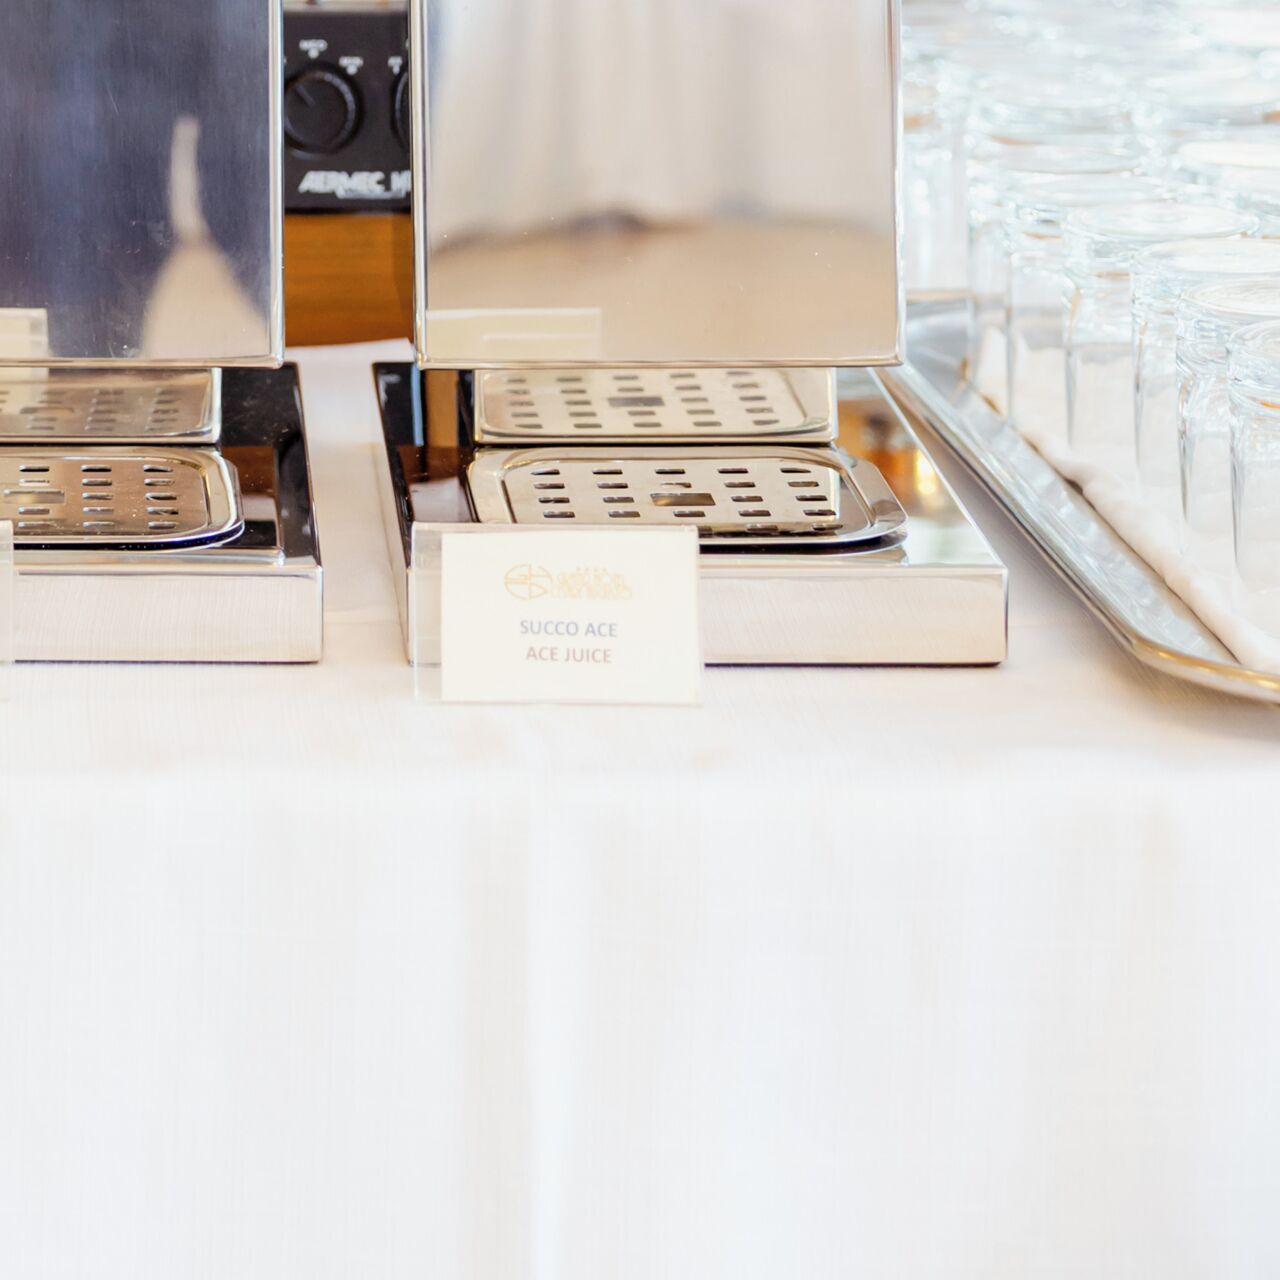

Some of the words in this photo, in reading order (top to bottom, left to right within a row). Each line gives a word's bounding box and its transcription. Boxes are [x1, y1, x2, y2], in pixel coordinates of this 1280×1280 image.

[519, 619, 579, 637] SUCCO
[584, 622, 618, 638] ACE
[526, 646, 558, 662] ACE
[564, 647, 613, 664] JUICE
